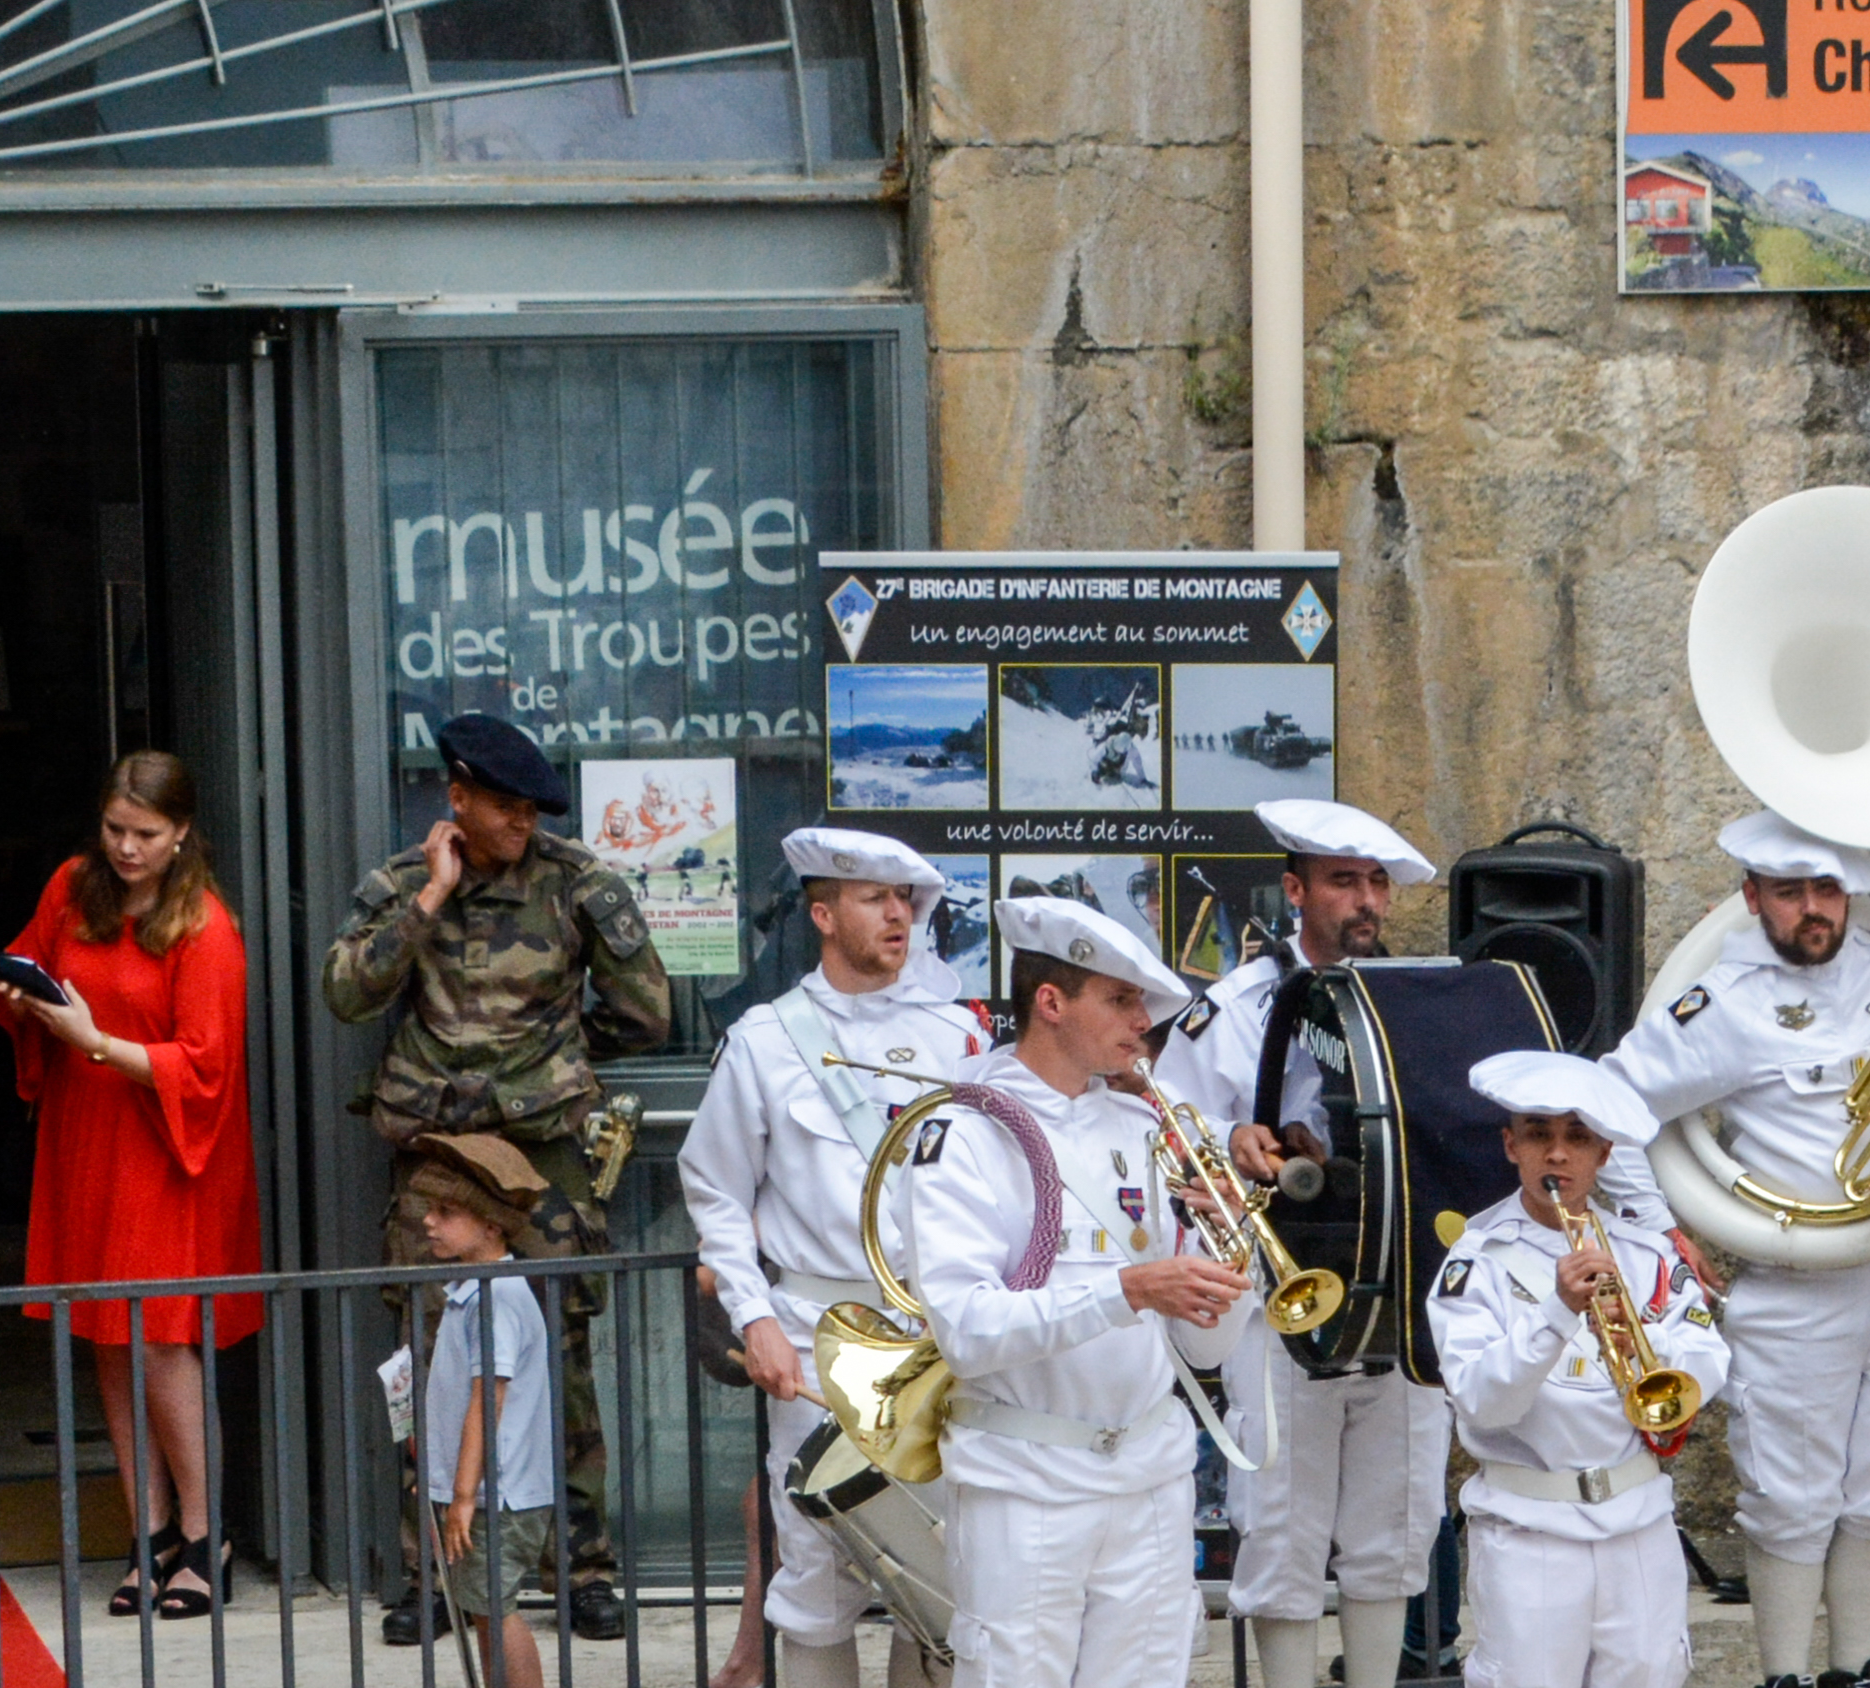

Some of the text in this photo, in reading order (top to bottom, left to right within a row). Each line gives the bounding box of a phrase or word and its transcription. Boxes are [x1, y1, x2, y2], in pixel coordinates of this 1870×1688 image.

[393, 467, 809, 604] musée
[909, 579, 995, 599] BRIGADE
[999, 579, 1128, 599] D'INFANTERIE
[1133, 579, 1160, 599] DE
[1165, 579, 1281, 599] MONTAGNE
[398, 609, 811, 682] des Troupes
[911, 622, 1250, 650] Un engagement au sommet
[511, 676, 559, 712] de
[946, 818, 1215, 842] une volonté de servir...
[1308, 1022, 1346, 1075] SONOR
